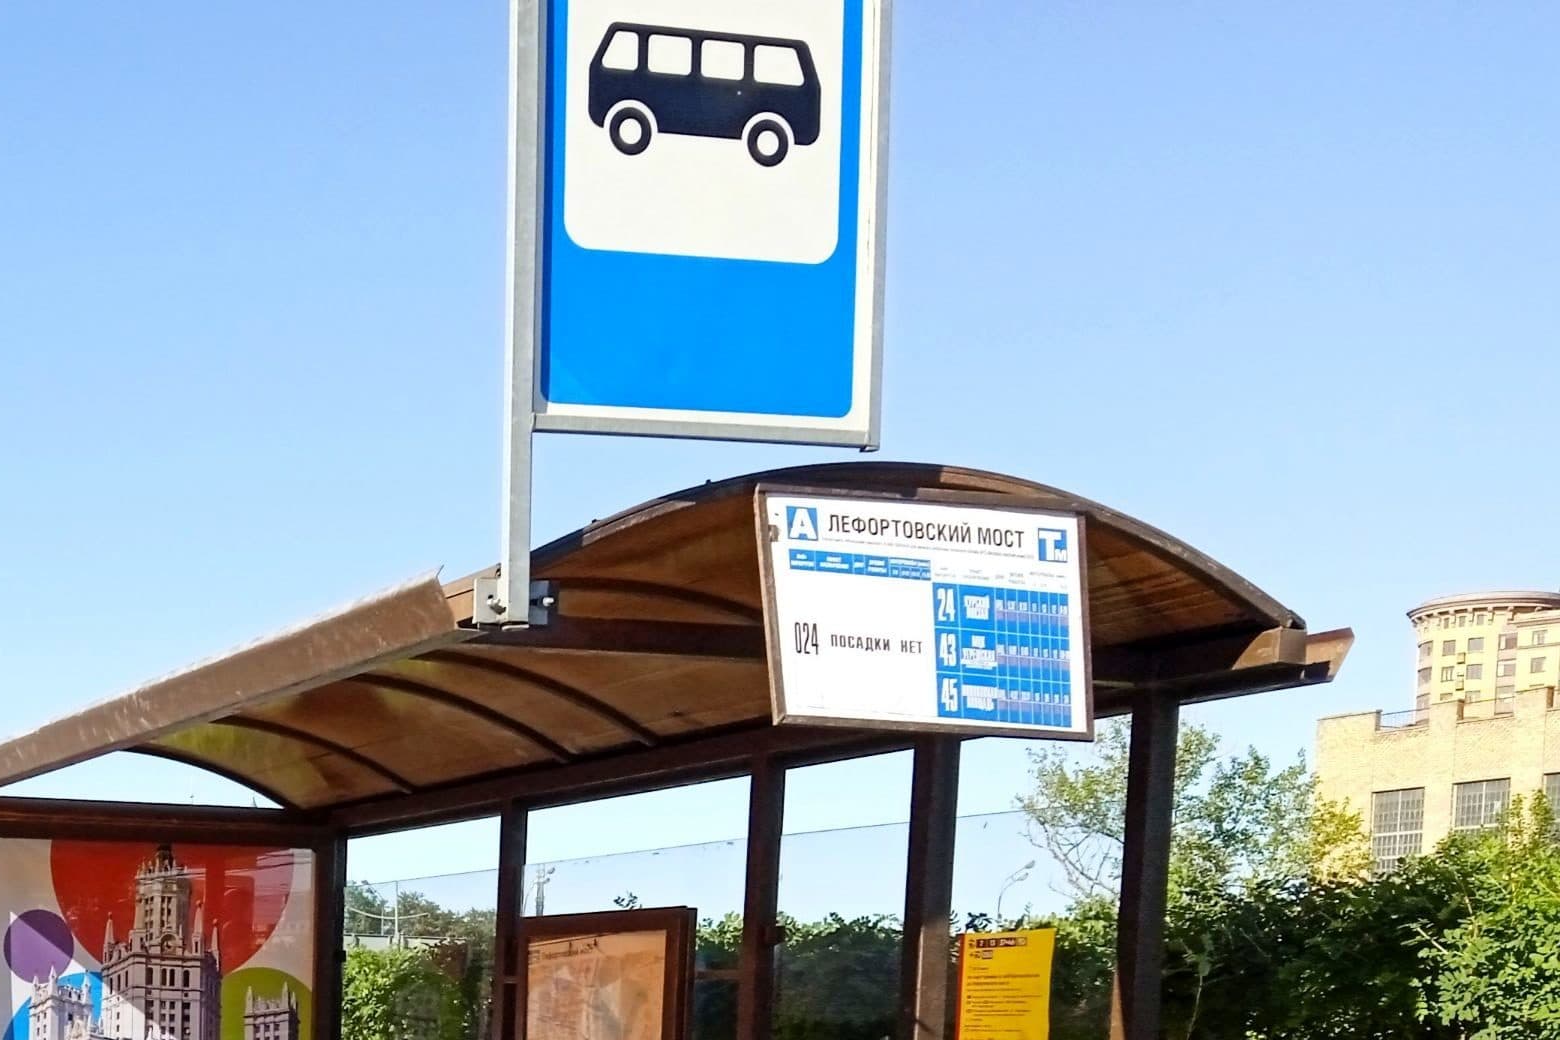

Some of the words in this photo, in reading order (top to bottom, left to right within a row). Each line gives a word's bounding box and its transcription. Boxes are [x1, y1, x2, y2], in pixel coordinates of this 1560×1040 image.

[828, 513, 972, 544] ЛЕФОРТОВСКИЙ
[977, 526, 1025, 549] МОСТ
[937, 587, 956, 622] 24
[794, 621, 819, 655] 024
[831, 634, 891, 652] ПОСАДКИ
[900, 639, 923, 654] НЕТ
[939, 632, 957, 667] 43
[941, 677, 958, 712] 45
